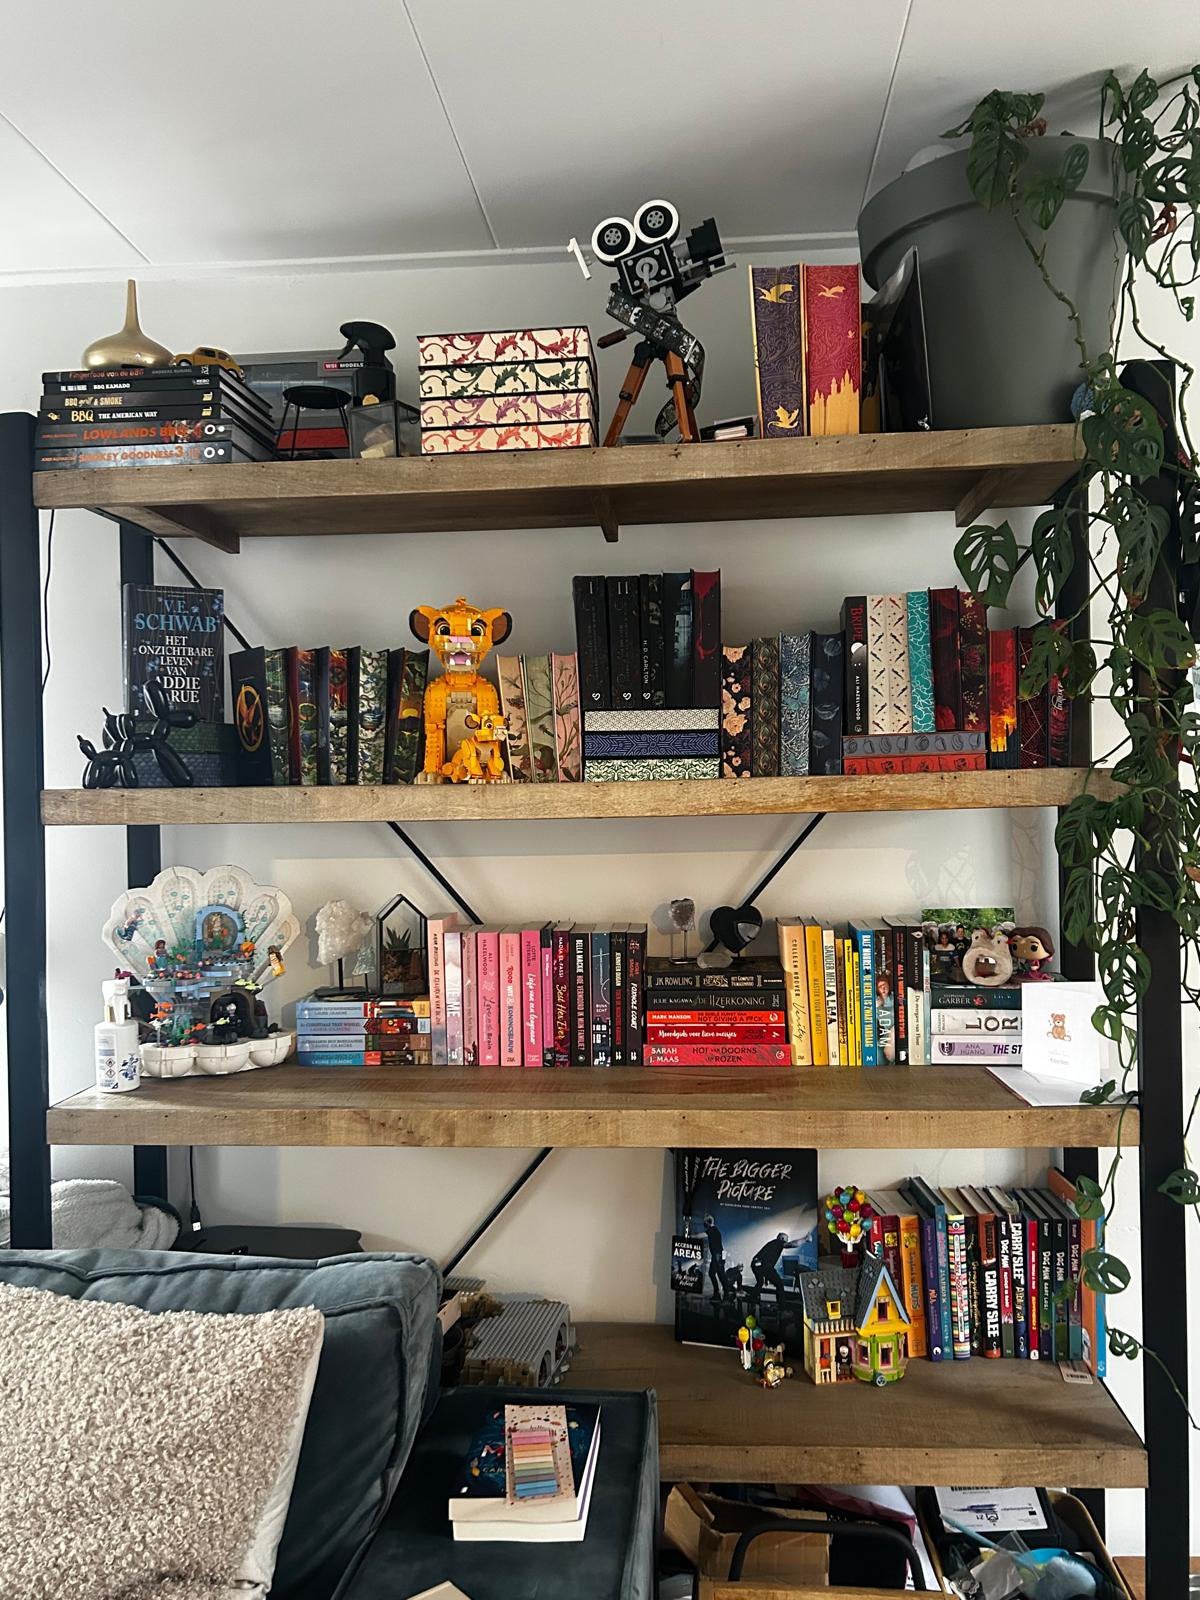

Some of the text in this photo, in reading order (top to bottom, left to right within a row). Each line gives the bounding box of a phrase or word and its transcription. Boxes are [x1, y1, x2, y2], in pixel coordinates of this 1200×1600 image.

[64, 397, 78, 406] BBQ
[100, 396, 123, 405] SMOKE
[71, 410, 94, 422] BBQ
[83, 427, 157, 440] LOWLANDS
[79, 452, 119, 462] SMOKEY
[121, 450, 174, 460] GOODNESS
[175, 446, 184, 458] 3
[135, 613, 217, 632] SCHWAB
[165, 636, 188, 646] HET
[138, 645, 214, 657] ONZICHTBARE
[160, 656, 193, 666] LEVEN
[166, 667, 187, 675] VAN
[156, 676, 200, 690] DDIE
[862, 935, 871, 947] RALF
[664, 977, 692, 986] ROWLING
[825, 945, 837, 1025] SANDER MEIJ ALMA
[864, 982, 872, 998] HEMEL
[447, 1002, 461, 1018] ME
[864, 1006, 873, 1023] ZWART
[793, 1003, 806, 1043] Verity
[879, 1009, 892, 1047] ADAM
[966, 1016, 1022, 1032] LOR
[865, 1024, 873, 1047] VANDAAG
[993, 1044, 1022, 1054] THE ST
[702, 1156, 730, 1180] THE
[730, 1159, 793, 1179] BIGGER
[674, 1248, 702, 1260] AREAS
[1001, 1239, 1009, 1253] DOG
[1011, 1223, 1024, 1280] CARRY SLEE
[911, 1284, 920, 1310] MUTS
[984, 1270, 998, 1308] CARRY
[987, 1309, 999, 1337] SLEE
